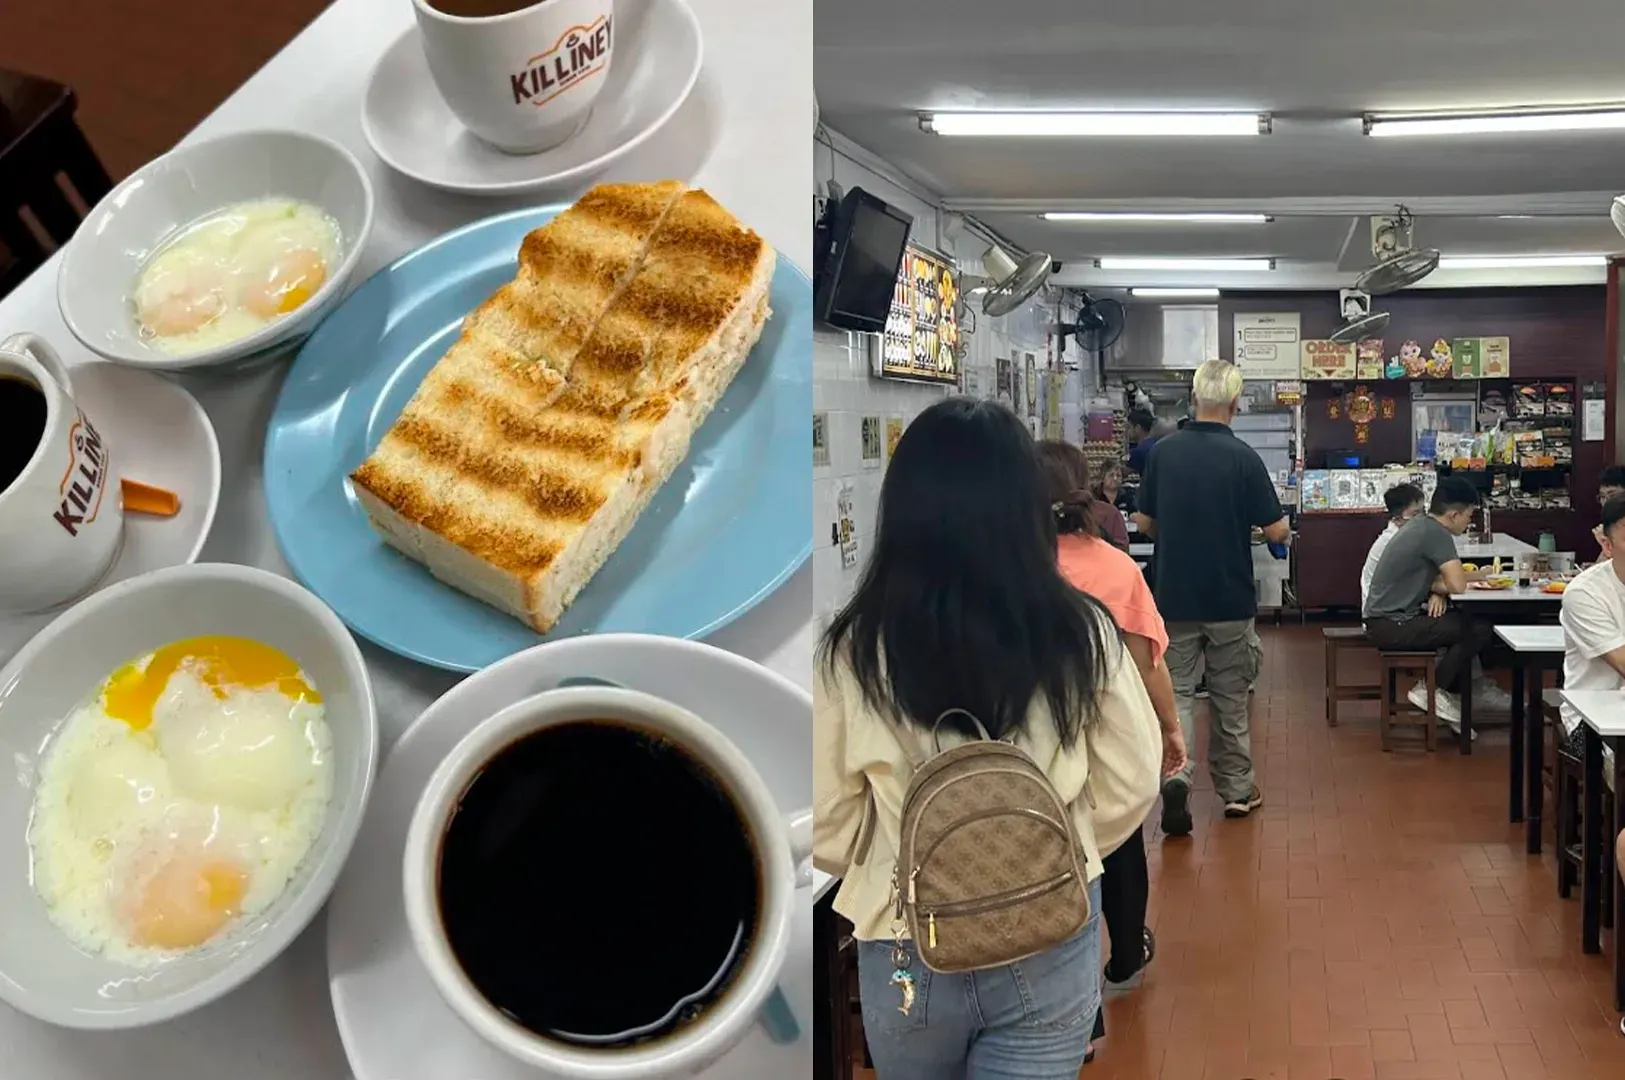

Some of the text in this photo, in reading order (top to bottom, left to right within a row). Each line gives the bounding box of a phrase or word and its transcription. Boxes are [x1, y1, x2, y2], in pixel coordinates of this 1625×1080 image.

[510, 14, 612, 105] KILLINEY
[1238, 330, 1242, 340] 1
[1237, 348, 1244, 358] 2
